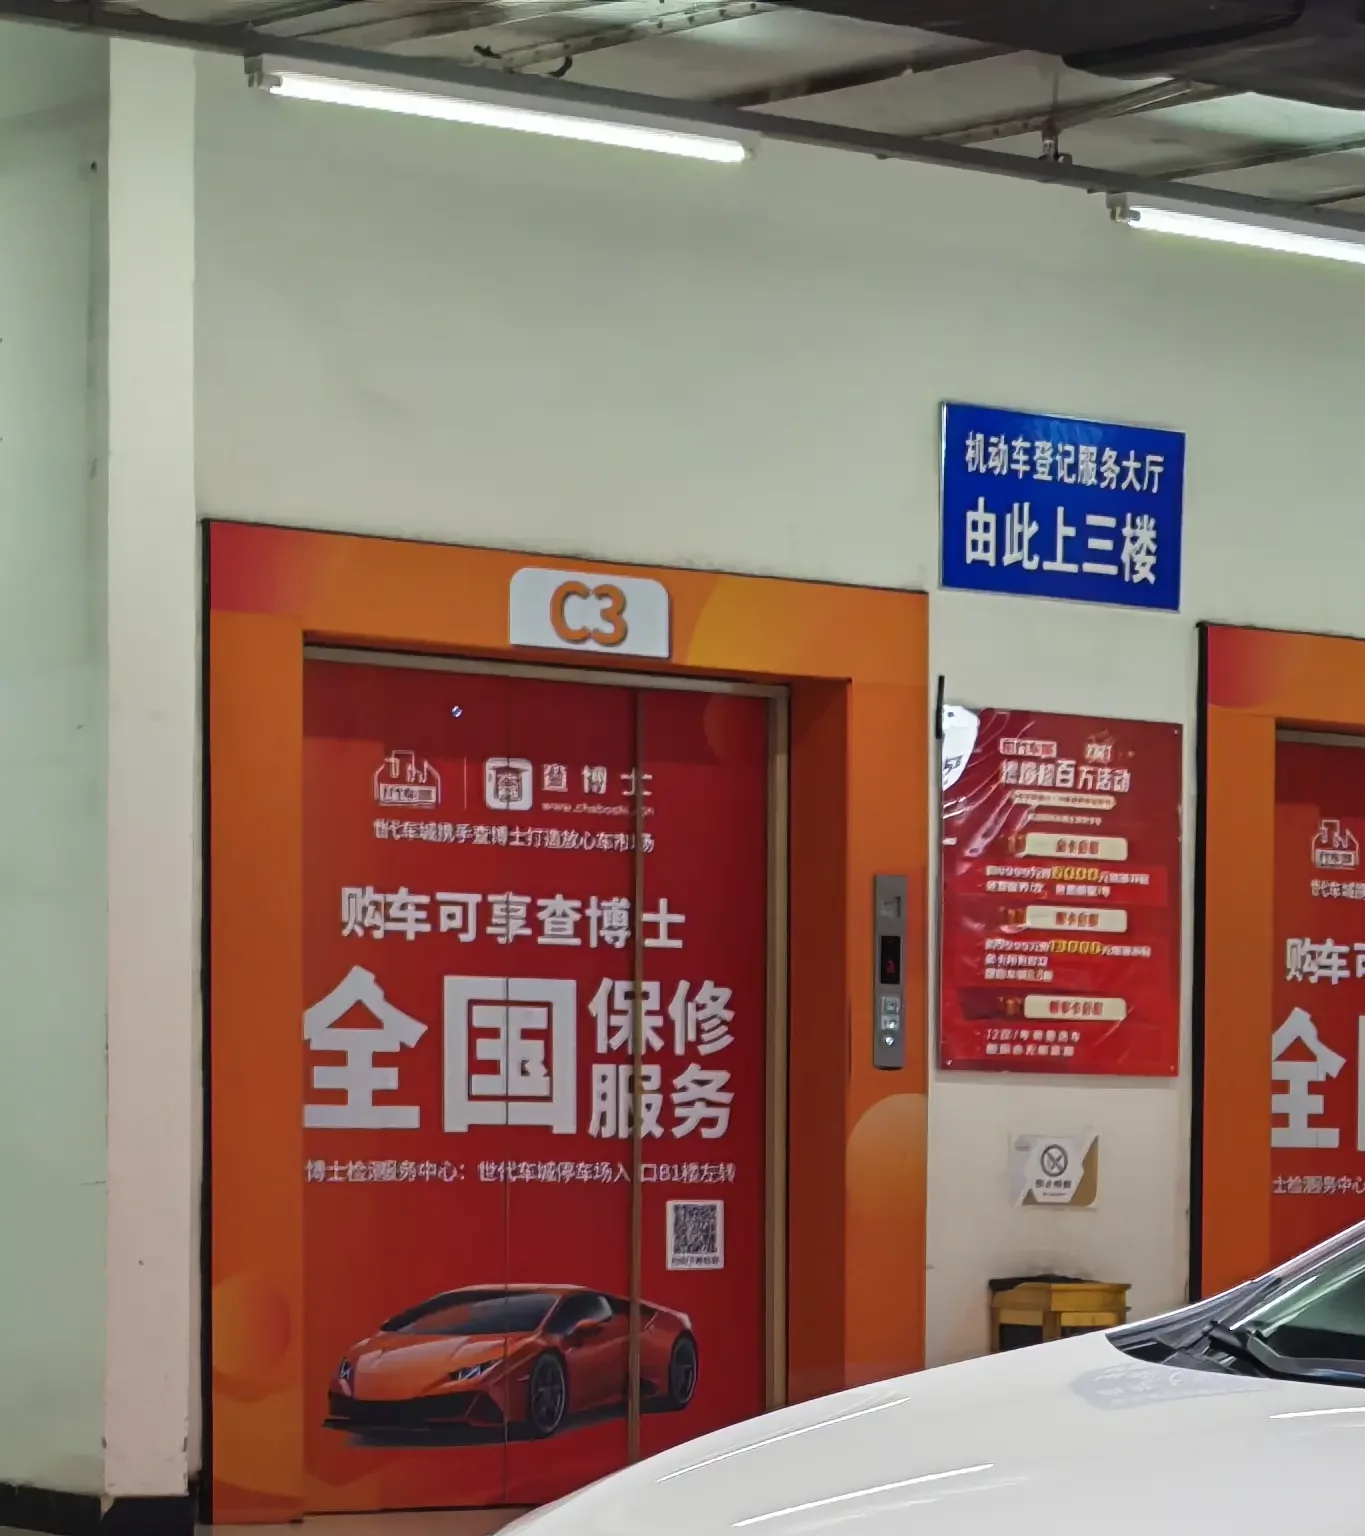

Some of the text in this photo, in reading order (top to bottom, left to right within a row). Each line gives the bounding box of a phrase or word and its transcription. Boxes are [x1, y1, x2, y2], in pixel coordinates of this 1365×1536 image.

[965, 430, 1165, 494] 机动车登记服务大厅
[965, 496, 1158, 585] 由此上三楼
[549, 580, 629, 646] C3
[341, 886, 686, 949] 购车可享查博士
[303, 964, 578, 1135] 全国
[587, 976, 736, 1057] 保修
[587, 1062, 736, 1141] 服务
